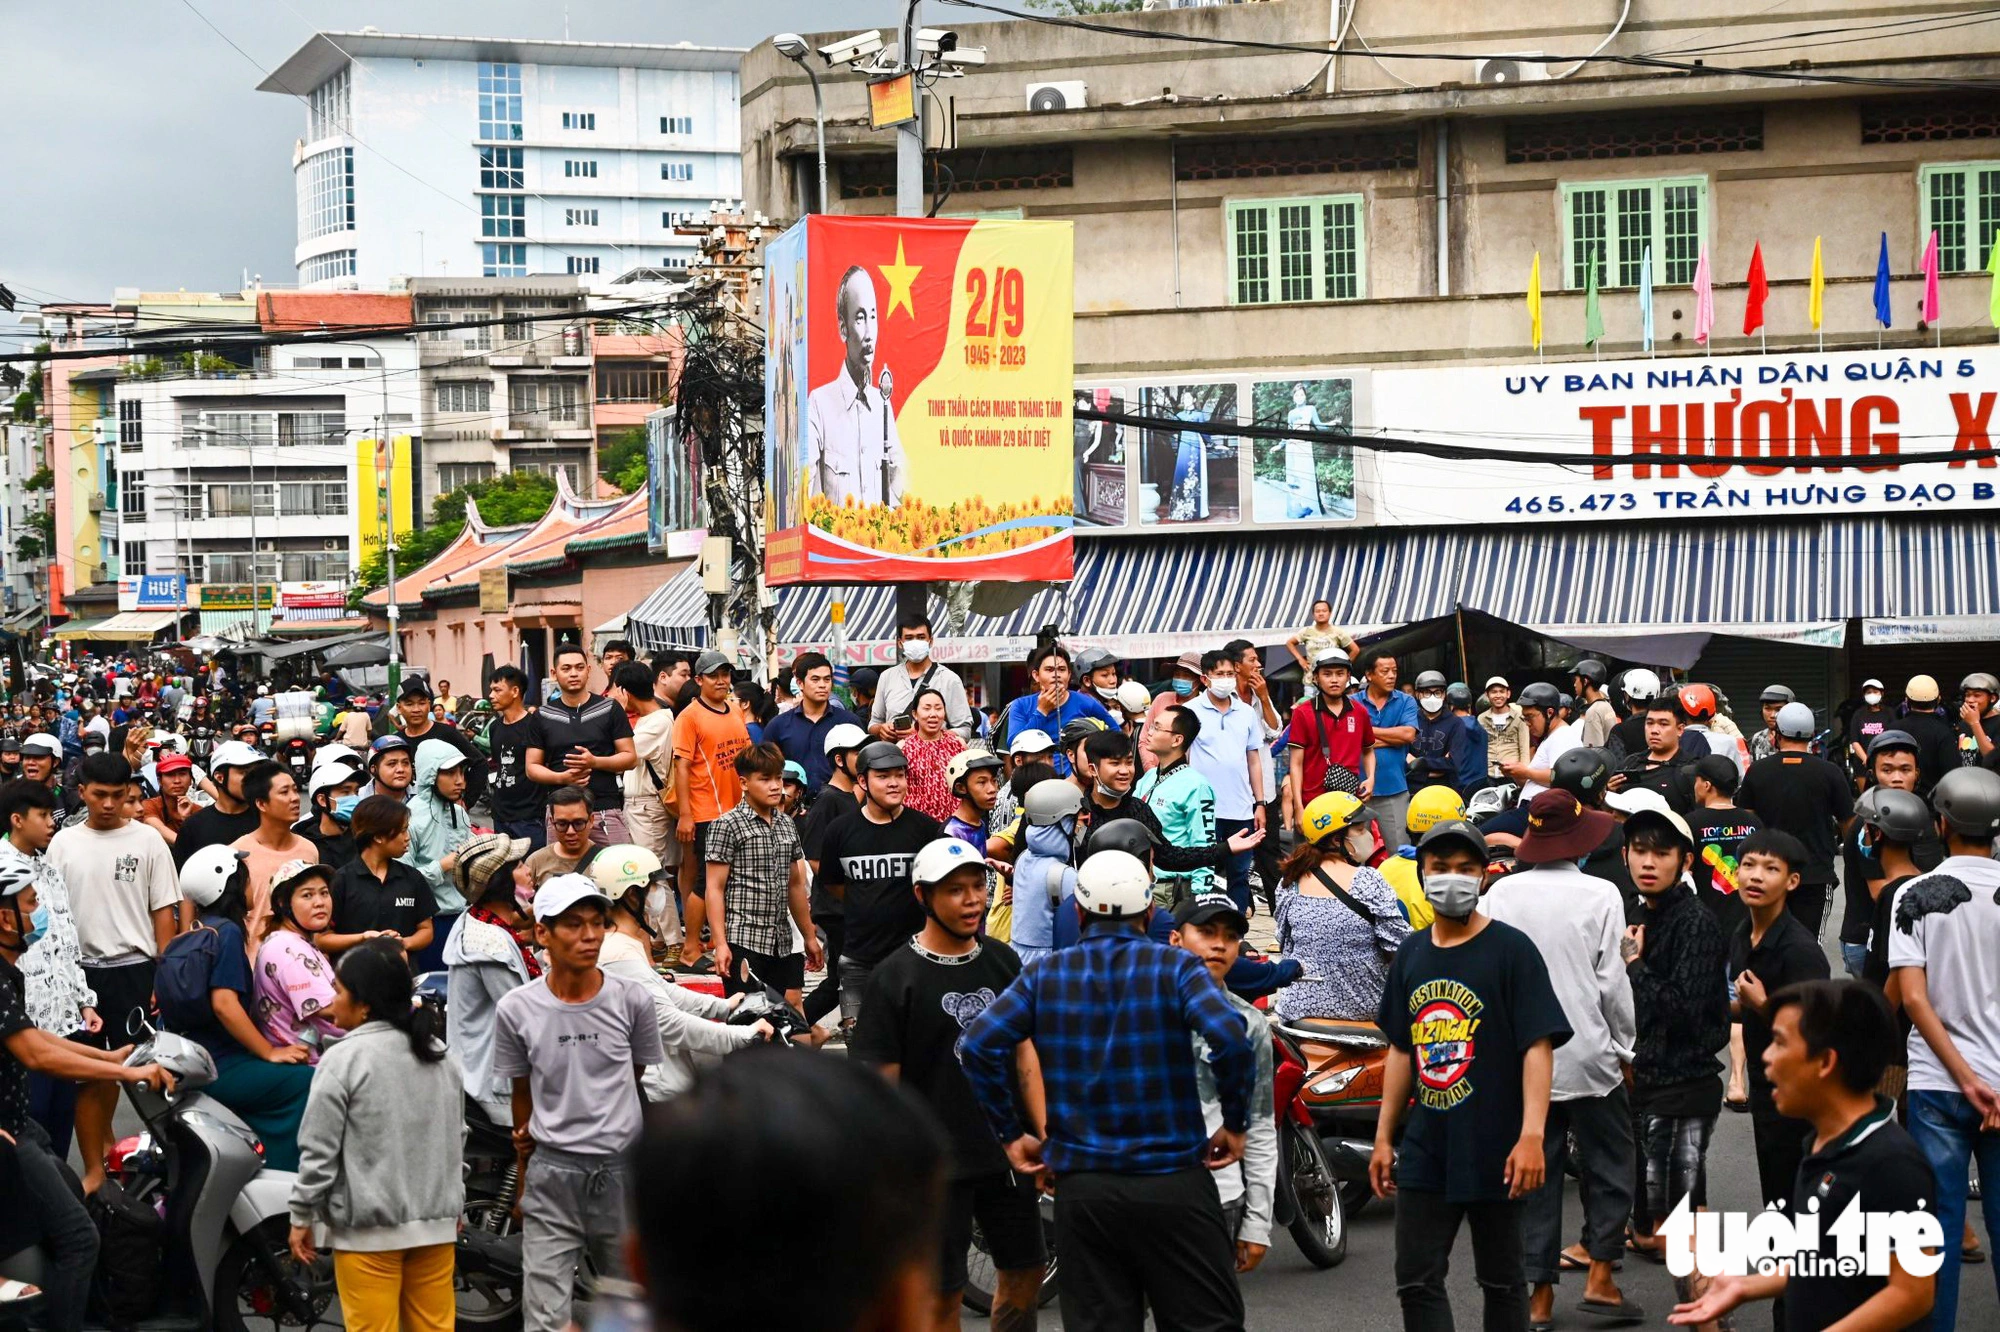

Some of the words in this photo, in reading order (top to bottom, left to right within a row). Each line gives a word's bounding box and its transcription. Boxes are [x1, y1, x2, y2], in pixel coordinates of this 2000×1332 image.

[966, 266, 1024, 337] 2/9
[964, 345, 989, 365] 1945
[1000, 345, 1026, 366] 2023
[1565, 372, 1634, 392] BAN
[1647, 365, 1742, 389] NHÂN
[1758, 362, 1828, 384] DÂN
[1844, 357, 1942, 383] QUẬN
[1957, 359, 1976, 377] 5
[927, 399, 946, 417] TINH
[948, 394, 968, 417] THẦN
[970, 396, 991, 417] CÁCH
[993, 400, 1016, 421] MẠNG
[1018, 397, 1043, 418] THÁNG
[1046, 397, 1062, 418] TÁM
[952, 423, 972, 448] QUỐC
[975, 426, 1001, 446] KHÁNH
[1003, 430, 1015, 447] 2/9
[1018, 424, 1032, 447] BẤT
[1034, 427, 1051, 451] DIỆT
[1579, 388, 1900, 480] THƯƠNG
[1505, 493, 1637, 514] 465.473
[1653, 482, 1749, 509] TRẦN
[1766, 484, 1866, 505] HƯNG
[1884, 483, 1955, 507] ĐẠO
[1973, 483, 1995, 501] B
[967, 645, 989, 659] 123
[1311, 813, 1332, 831] be
[938, 956, 959, 964] DIOR
[1408, 979, 1485, 1017] DESTINATION
